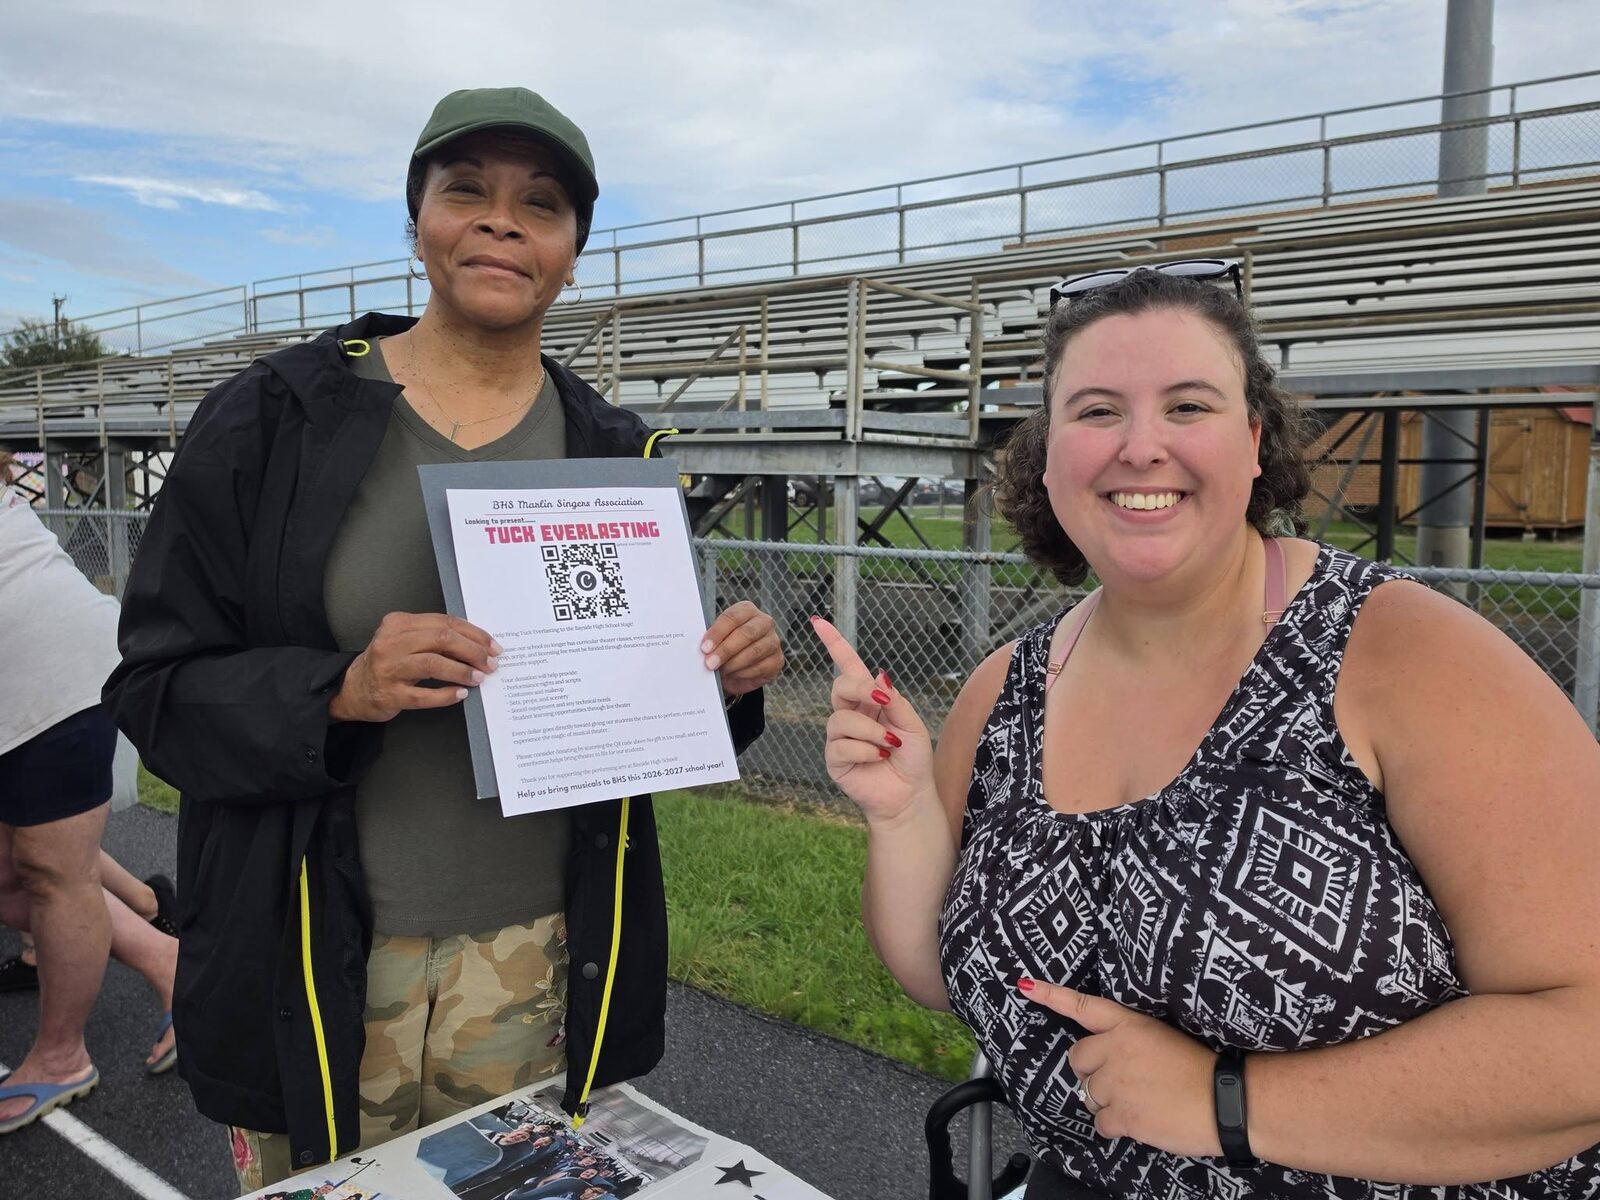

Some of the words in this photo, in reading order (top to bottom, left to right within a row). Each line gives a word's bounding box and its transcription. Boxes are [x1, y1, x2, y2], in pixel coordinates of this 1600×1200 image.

[492, 500, 514, 510] BHS
[518, 500, 553, 510] Marlin
[556, 499, 590, 510] Singers
[594, 498, 644, 507] Association
[484, 526, 536, 544] TUCK
[540, 522, 660, 542] EVERLASTING
[517, 790, 536, 800] Help
[548, 784, 569, 795] bring
[570, 779, 601, 790] musicals
[612, 776, 626, 784] BHS
[628, 773, 641, 782] this
[642, 767, 684, 779] 2026-2027
[685, 764, 706, 772] school
[706, 761, 725, 771] year!
